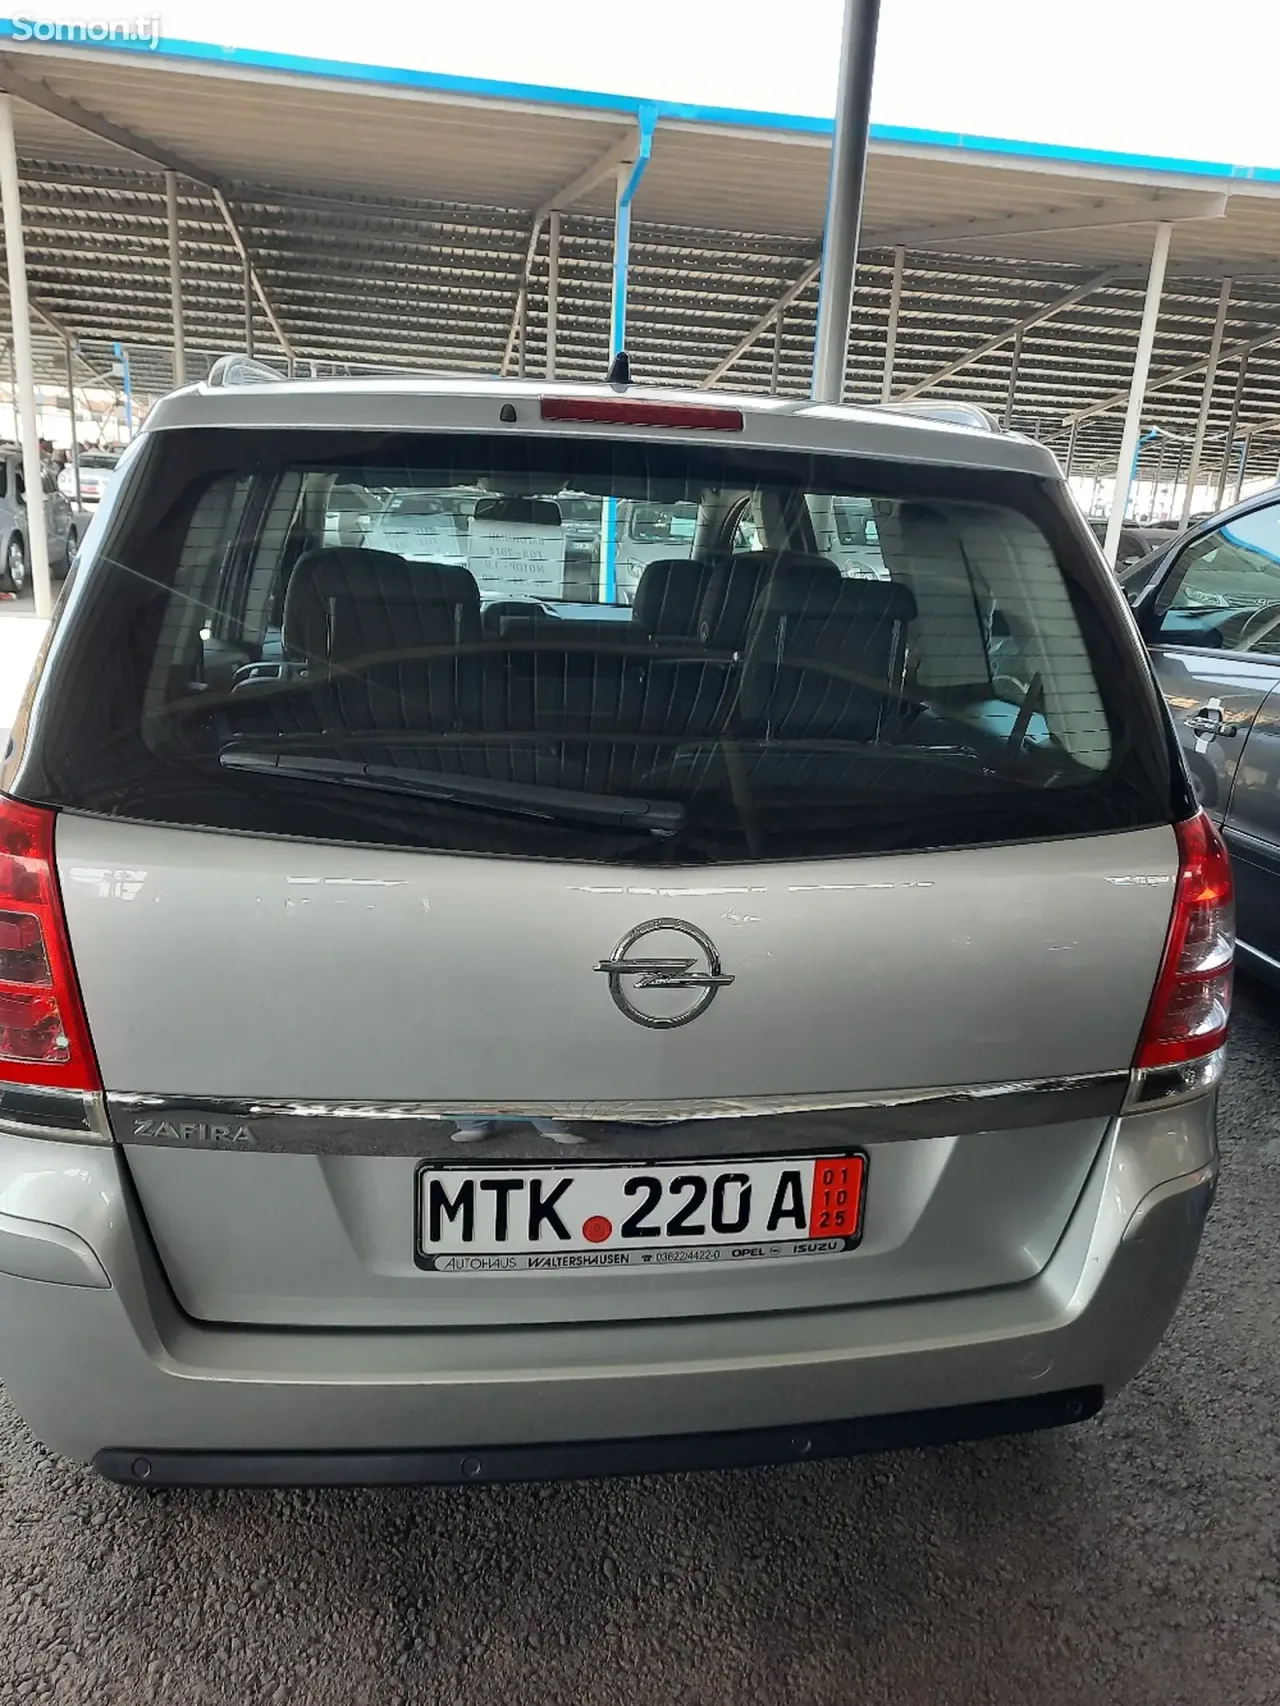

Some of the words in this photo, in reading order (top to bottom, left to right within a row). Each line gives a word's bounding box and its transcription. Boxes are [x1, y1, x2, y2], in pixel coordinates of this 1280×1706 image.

[133, 1119, 259, 1145] ZAFIRA
[823, 1167, 848, 1185] 01
[428, 1178, 574, 1242] MTK
[621, 1172, 752, 1238] 220
[766, 1170, 807, 1232] A
[824, 1188, 848, 1206] 10
[819, 1210, 846, 1229] 25
[444, 1256, 517, 1271] AUTOHAUS
[527, 1253, 630, 1269] WALTERSHAUSEN
[655, 1250, 721, 1263] 03622/4422-0
[731, 1247, 766, 1258] OPEL
[792, 1242, 838, 1254] ISUZU
